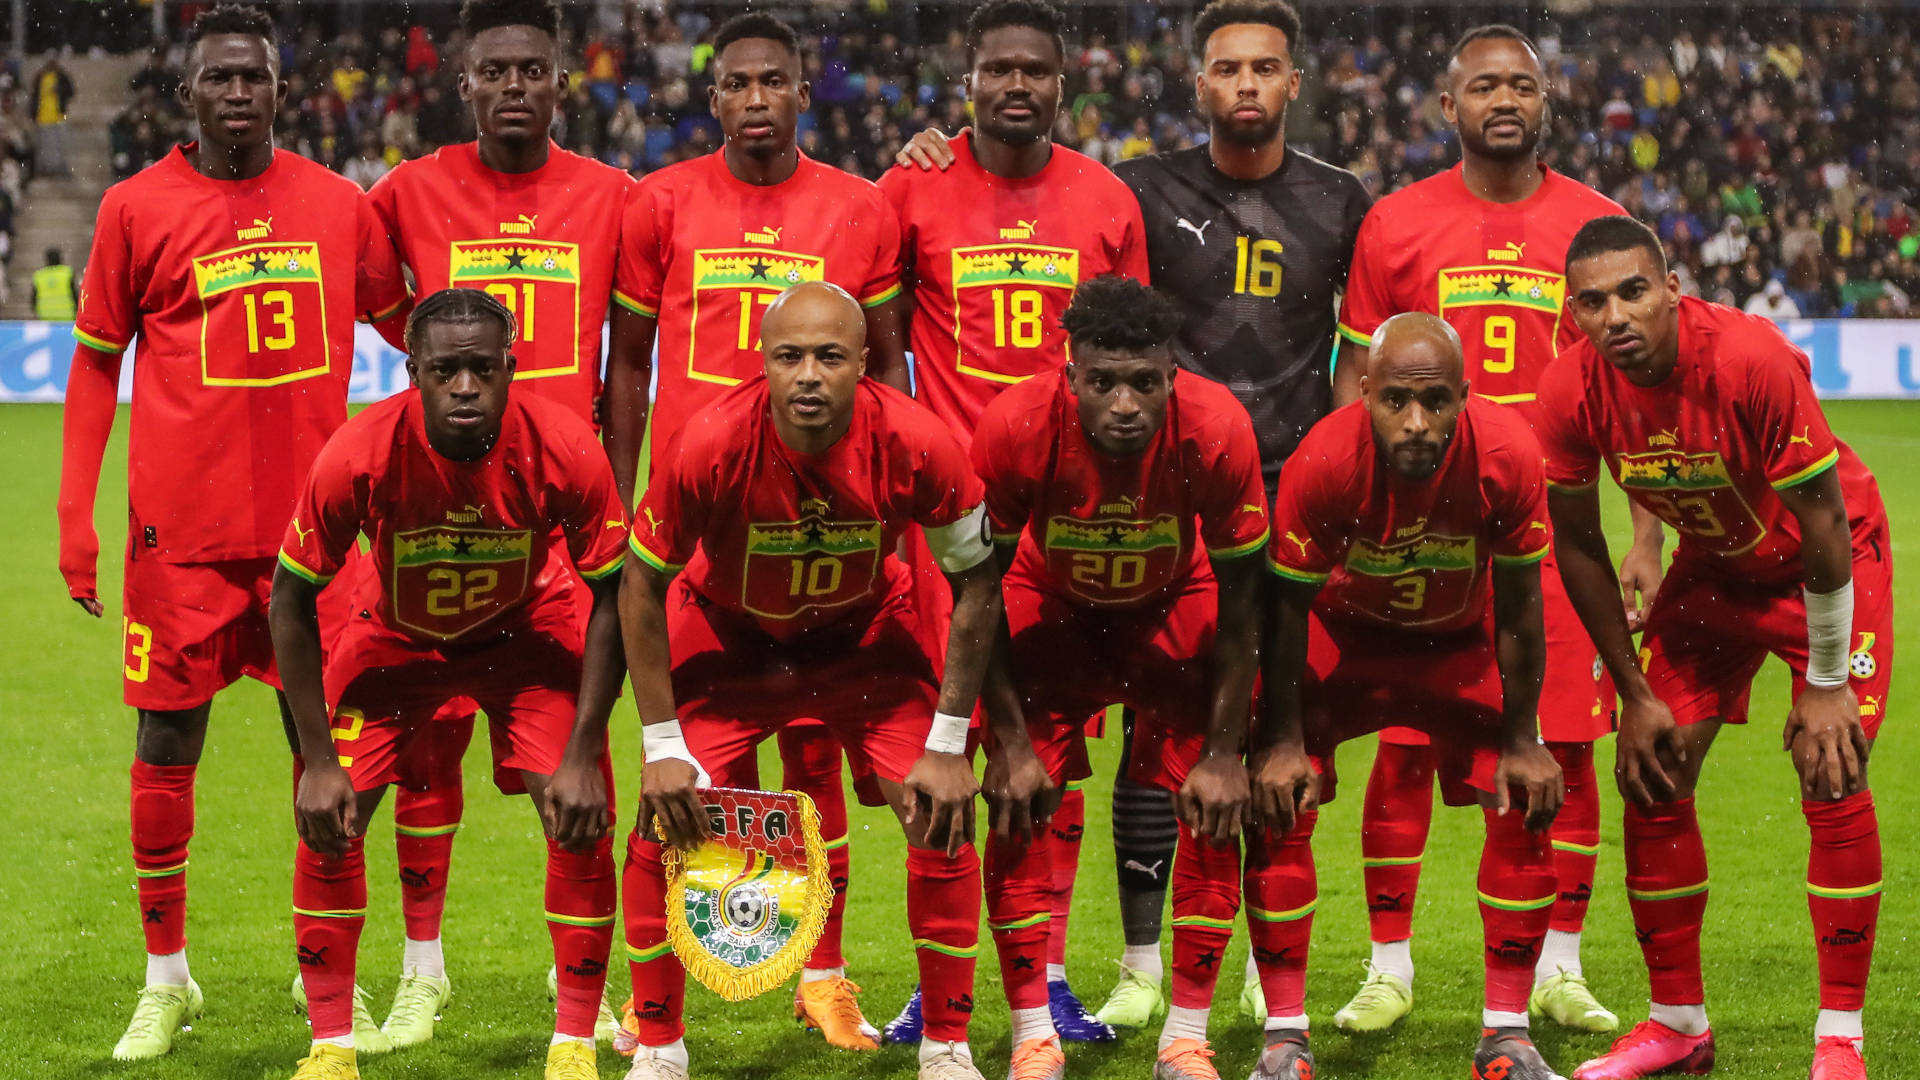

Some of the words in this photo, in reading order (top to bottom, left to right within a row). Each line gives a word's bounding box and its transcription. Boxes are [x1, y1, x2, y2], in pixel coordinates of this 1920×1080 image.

[237, 227, 269, 241] PUMA
[500, 222, 531, 234] PUMA
[744, 232, 775, 244] PUMA
[1000, 228, 1031, 239] PUMA
[1234, 236, 1284, 297] 16
[1487, 249, 1518, 261] PUMA
[243, 290, 296, 353] 13
[992, 289, 1043, 348] 18
[1483, 315, 1516, 373] 9
[446, 510, 478, 523] PUMA
[1647, 495, 1726, 536] 23
[789, 556, 843, 596] 10
[1071, 553, 1147, 589] 20
[426, 568, 498, 616] 22
[1389, 575, 1427, 610] 3
[704, 804, 789, 843] GFA
[750, 895, 778, 944] ASSOCIATIO
